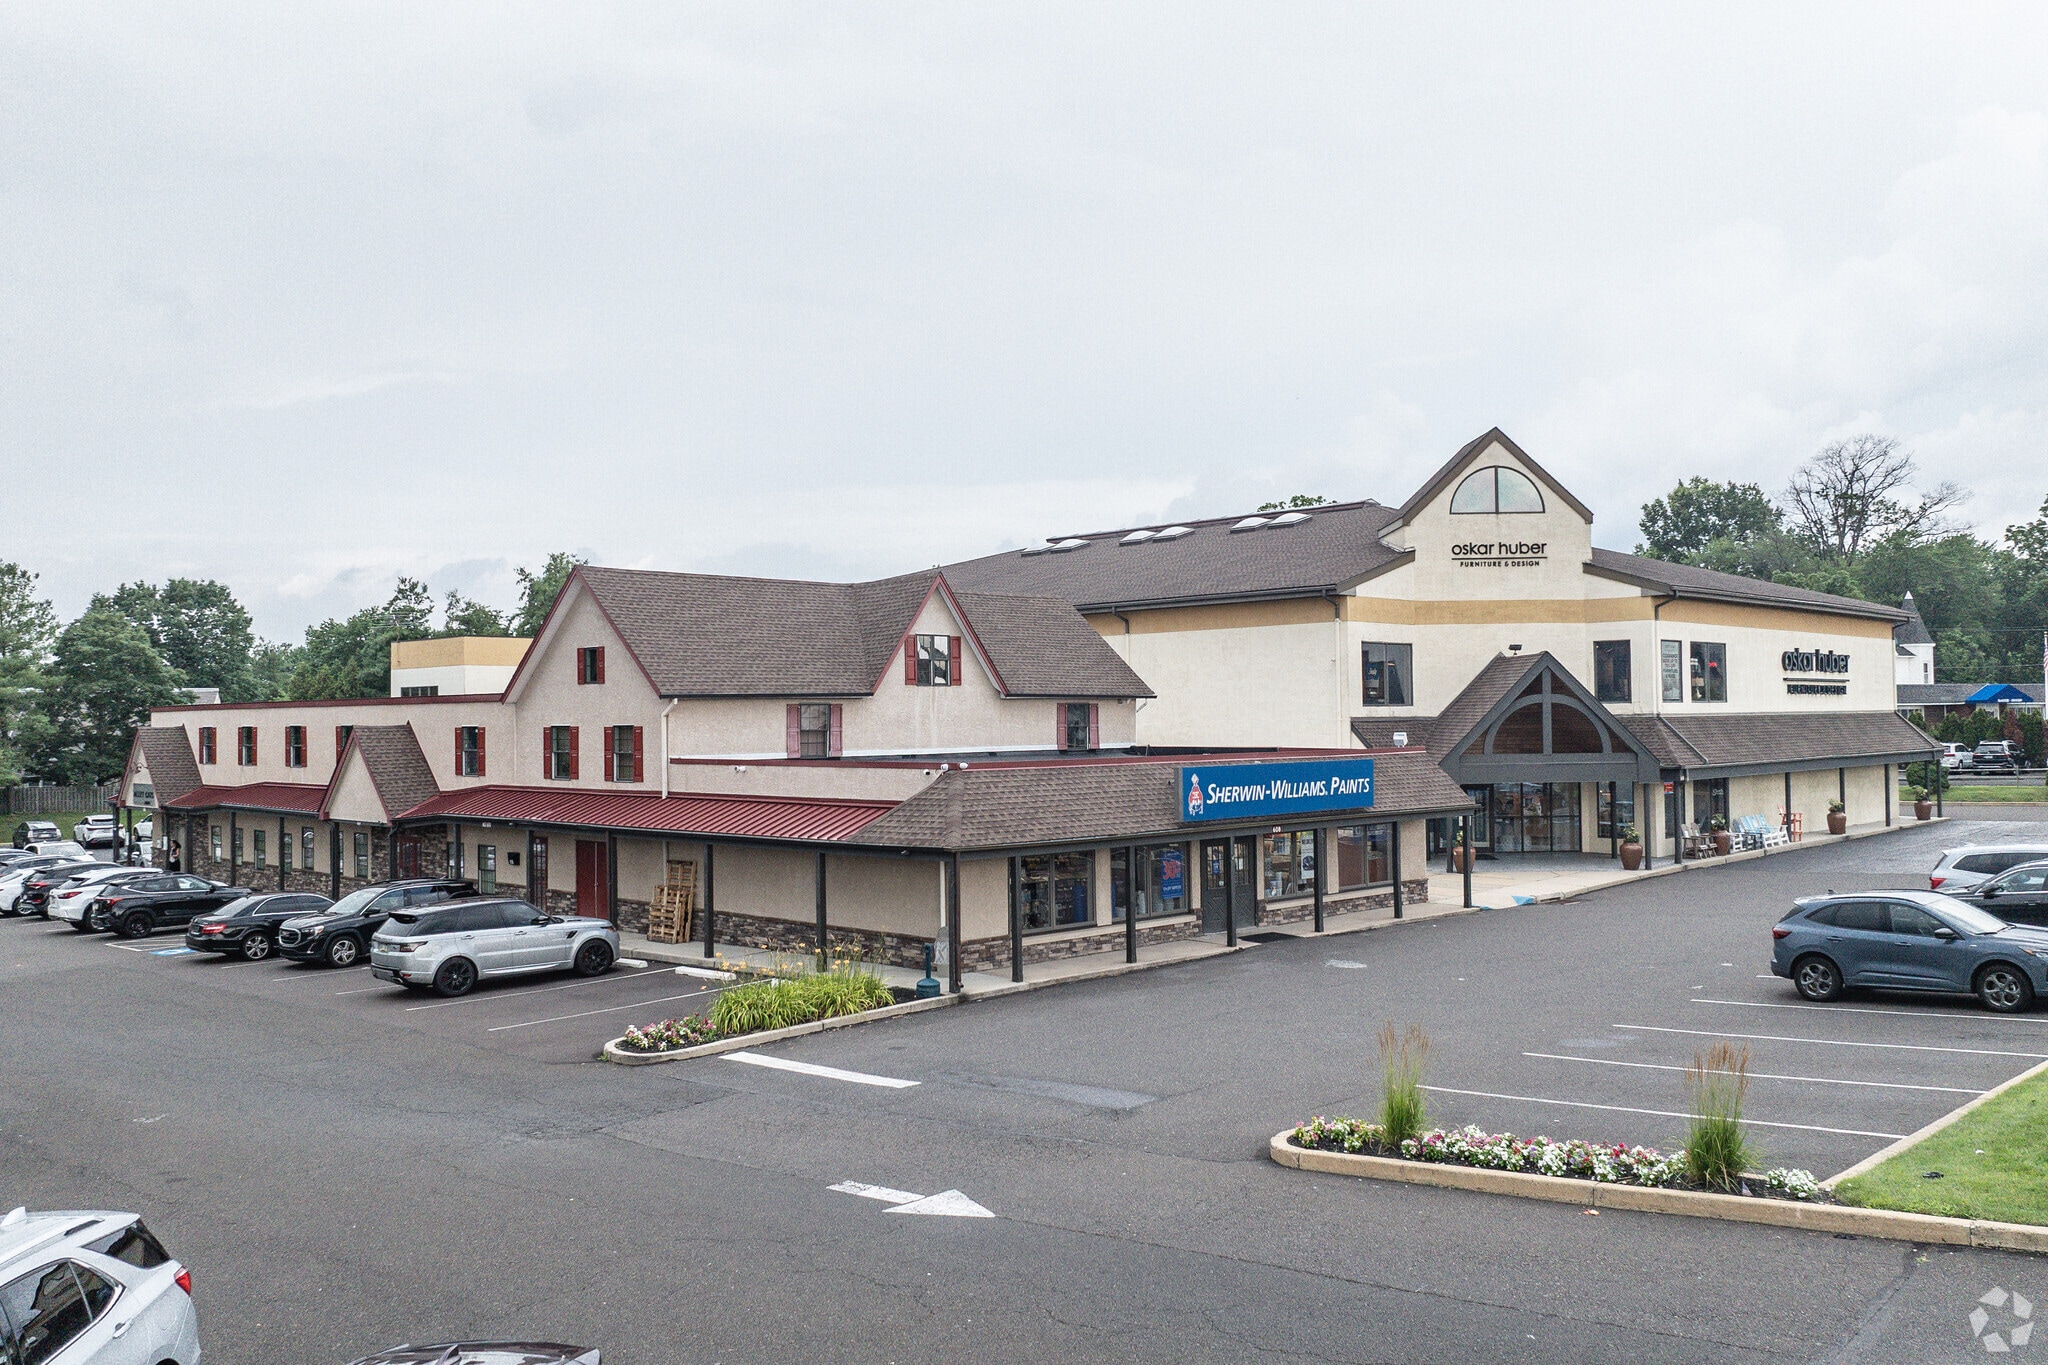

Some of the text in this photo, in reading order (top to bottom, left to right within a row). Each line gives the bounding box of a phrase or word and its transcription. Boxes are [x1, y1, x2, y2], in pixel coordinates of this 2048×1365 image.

[1451, 541, 1547, 555] oskar huber
[1782, 648, 1850, 673] oskar huber
[1330, 776, 1370, 796] PAINTS
